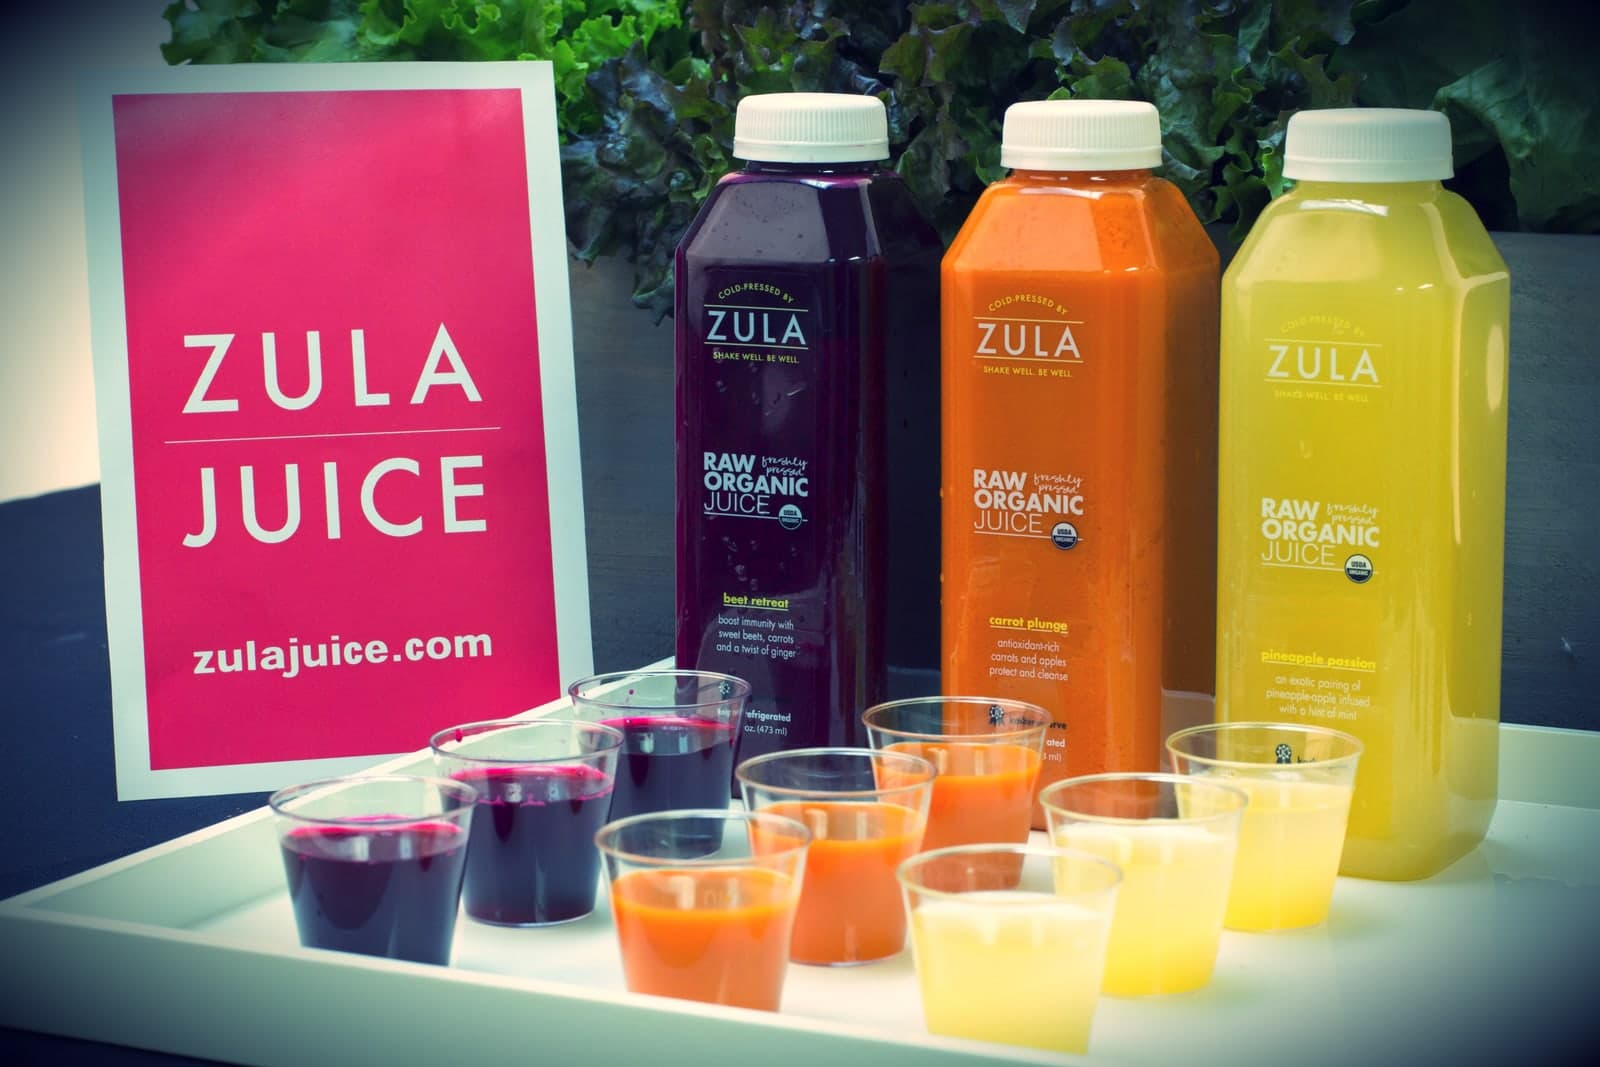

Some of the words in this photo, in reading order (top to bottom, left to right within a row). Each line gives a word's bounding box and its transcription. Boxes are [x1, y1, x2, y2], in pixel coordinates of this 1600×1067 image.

[718, 283, 781, 300] COLD-PRESSED
[783, 293, 794, 304] BY
[988, 294, 1055, 312] COLD-PRESSED
[1055, 304, 1068, 315] BY
[706, 310, 807, 345] ZULA
[976, 322, 1081, 358] ZULA
[713, 351, 739, 360] SHAKE
[767, 354, 776, 362] BE
[1267, 345, 1379, 383] ZULA
[181, 322, 483, 414] ZULA
[983, 365, 1010, 374] SHAKE
[1038, 368, 1049, 376] BE
[703, 451, 756, 473] RAW
[761, 456, 808, 470] freshly
[766, 466, 804, 477] pressed
[973, 468, 1028, 491] RAW
[1033, 472, 1084, 488] freshly
[703, 471, 809, 497] ORGANIC
[1038, 483, 1079, 495] pressed
[181, 455, 487, 549] JUICE
[703, 491, 770, 514] JUICE
[973, 489, 1085, 516] ORGANIC
[1261, 497, 1320, 521] RAW
[1326, 503, 1378, 519] freshly
[973, 510, 1043, 534] JUICE
[1261, 518, 1380, 548] ORGANIC
[1261, 540, 1336, 566] JUICE
[1351, 560, 1367, 568] USDA
[723, 592, 748, 605] beet
[751, 597, 789, 609] retreat
[718, 613, 740, 625] boost
[741, 616, 776, 631] immunity
[778, 619, 795, 631] with
[989, 616, 1024, 627] carrot
[1027, 617, 1068, 632] plunge
[718, 630, 740, 639] sweet
[742, 629, 766, 642] beets,
[767, 633, 795, 644] carrots
[716, 641, 732, 652] and
[741, 645, 759, 655] twist
[761, 645, 769, 656] of
[770, 648, 796, 660] ginger
[997, 639, 1060, 653] antioxidant-rich
[193, 631, 493, 680] zulajuice.com
[991, 653, 1018, 663] carrots
[1021, 654, 1037, 665] and
[1039, 656, 1067, 669] apples
[1261, 649, 1325, 665] pineapple
[1327, 657, 1376, 670] passion
[989, 667, 1017, 678] protect
[1019, 668, 1036, 678] and
[1037, 669, 1069, 681] cleanse
[1275, 676, 1286, 684] an
[1290, 677, 1315, 687] exotic
[1318, 679, 1349, 692] pairing
[1351, 680, 1361, 690] of
[1340, 695, 1371, 706] infused
[1280, 703, 1297, 713] with
[1309, 704, 1325, 717] hint
[1327, 708, 1336, 718] of
[1338, 709, 1357, 720] mint
[744, 725, 756, 733] oz.
[757, 725, 774, 735] (473
[775, 727, 788, 737] ml)
